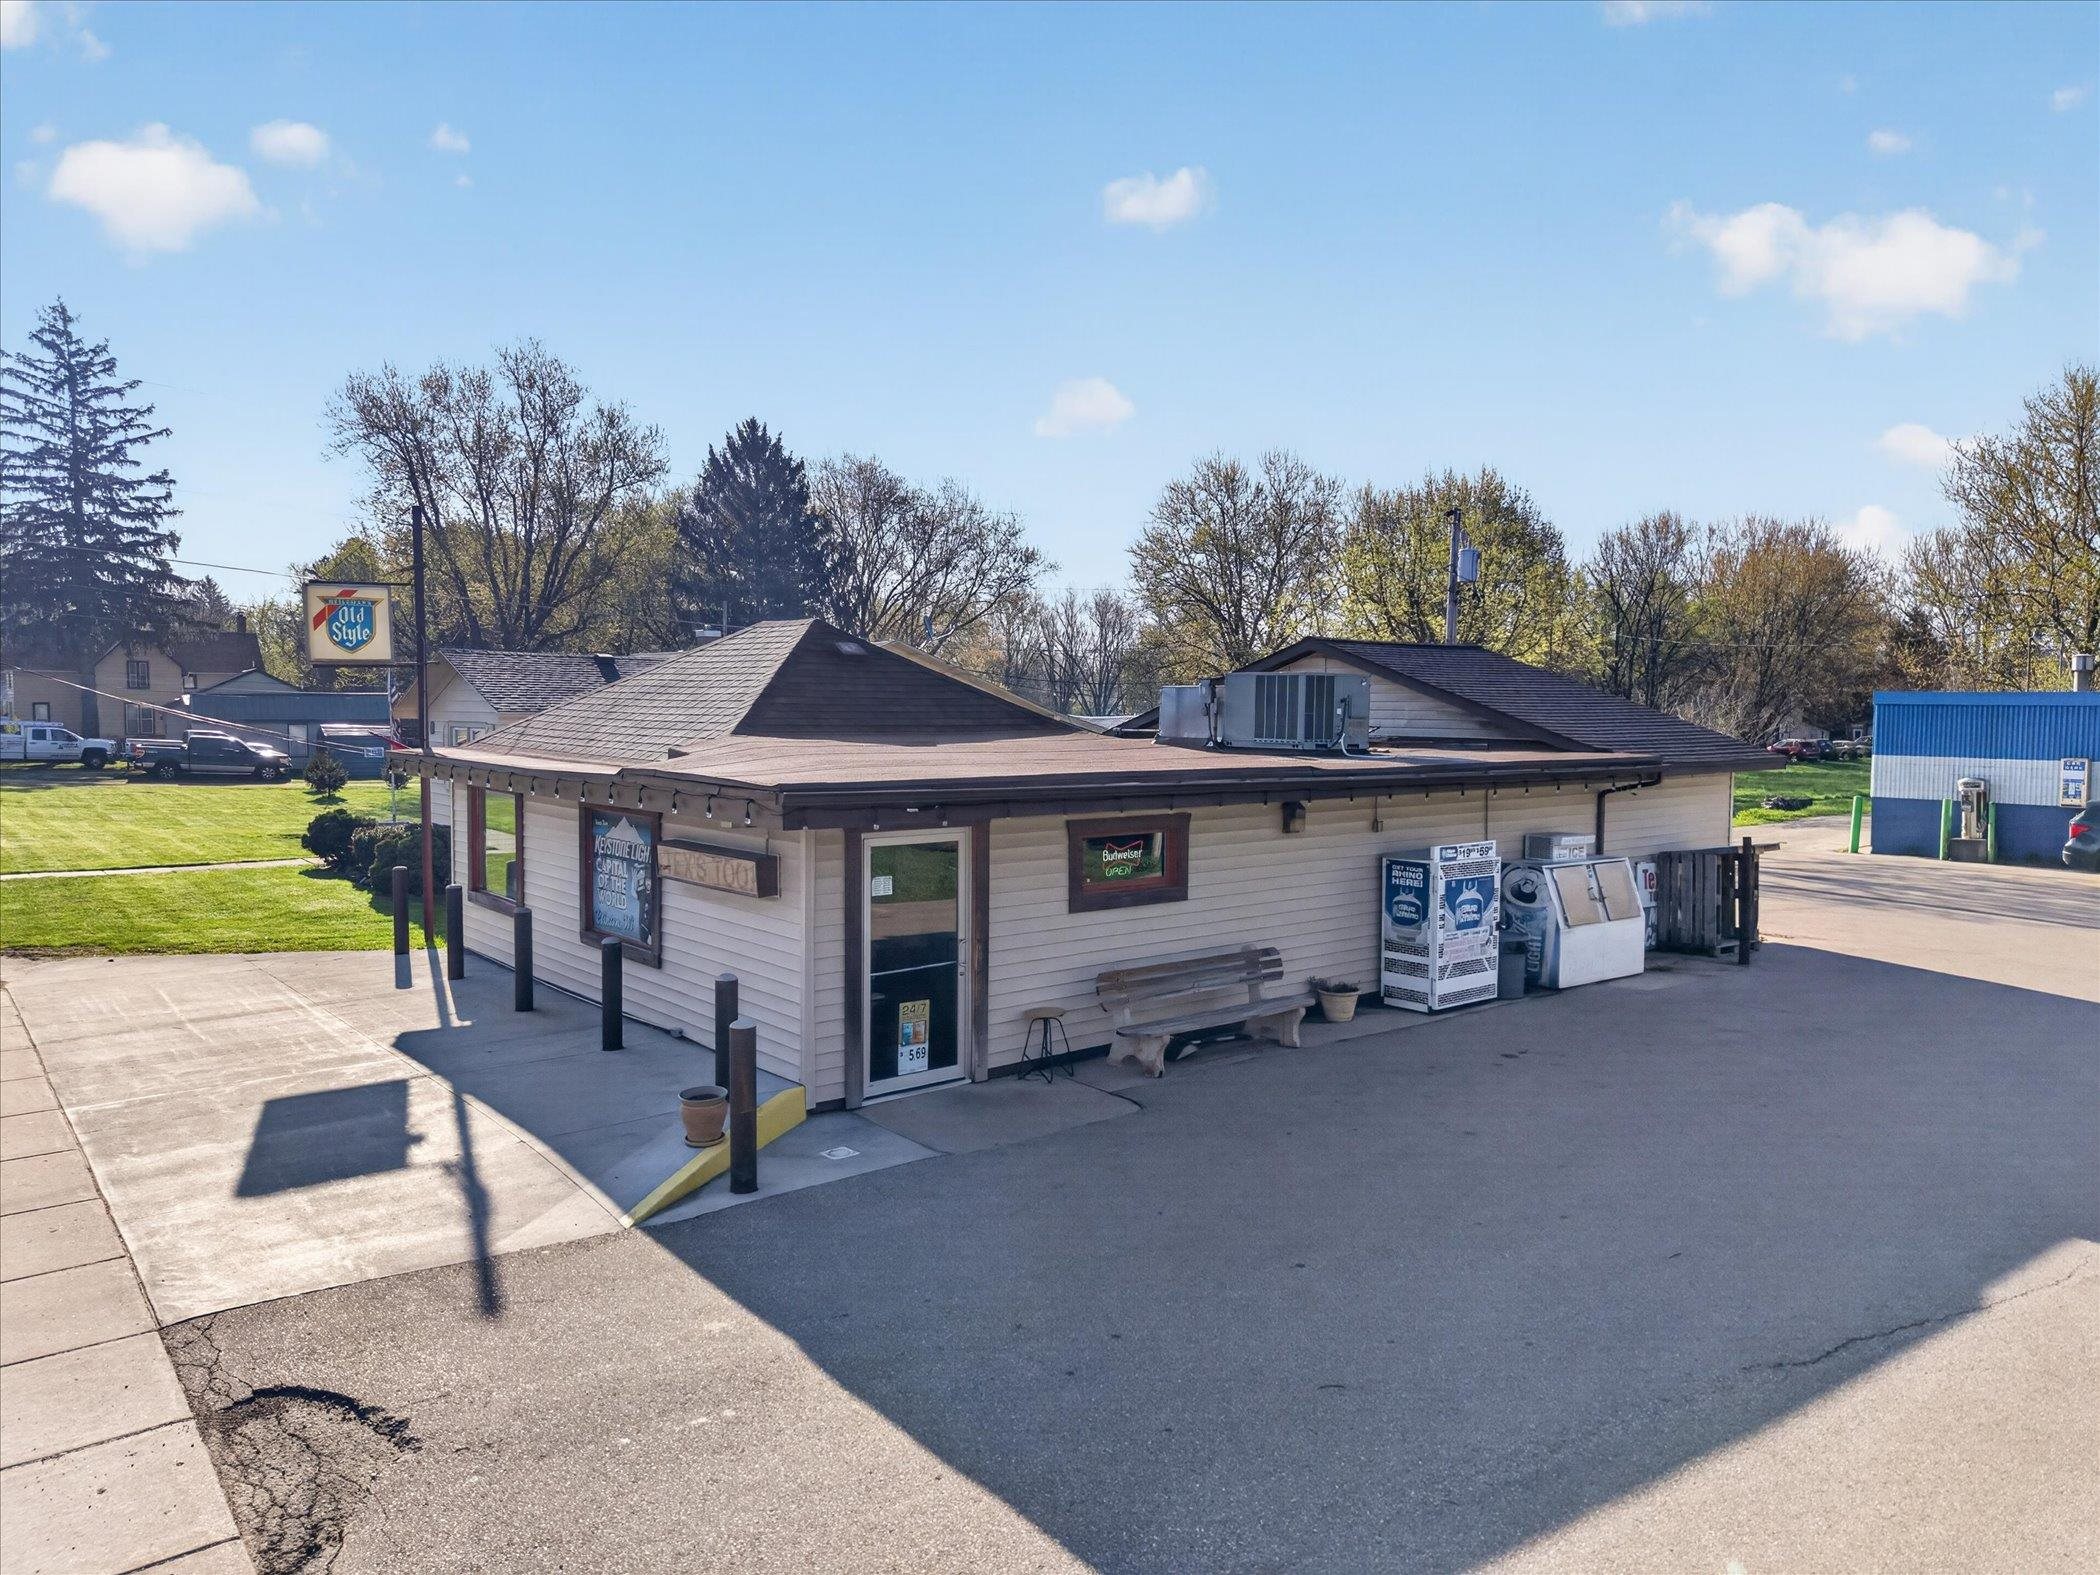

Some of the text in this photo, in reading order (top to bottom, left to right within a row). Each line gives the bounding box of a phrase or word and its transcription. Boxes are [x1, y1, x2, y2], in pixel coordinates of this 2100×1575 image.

[338, 606, 364, 623] Old
[332, 621, 370, 647] Style
[595, 834, 630, 858] KEYSTONE
[1102, 848, 1142, 862] Budweiser
[596, 857, 628, 879] CAPITAL
[1105, 865, 1132, 877] OPEN
[1392, 870, 1424, 880] RHINO
[598, 874, 626, 894] OF THE
[1642, 869, 1657, 889] Te
[599, 889, 627, 910] WORLD
[902, 1004, 927, 1016] 24/7
[909, 1047, 926, 1061] 5.69
